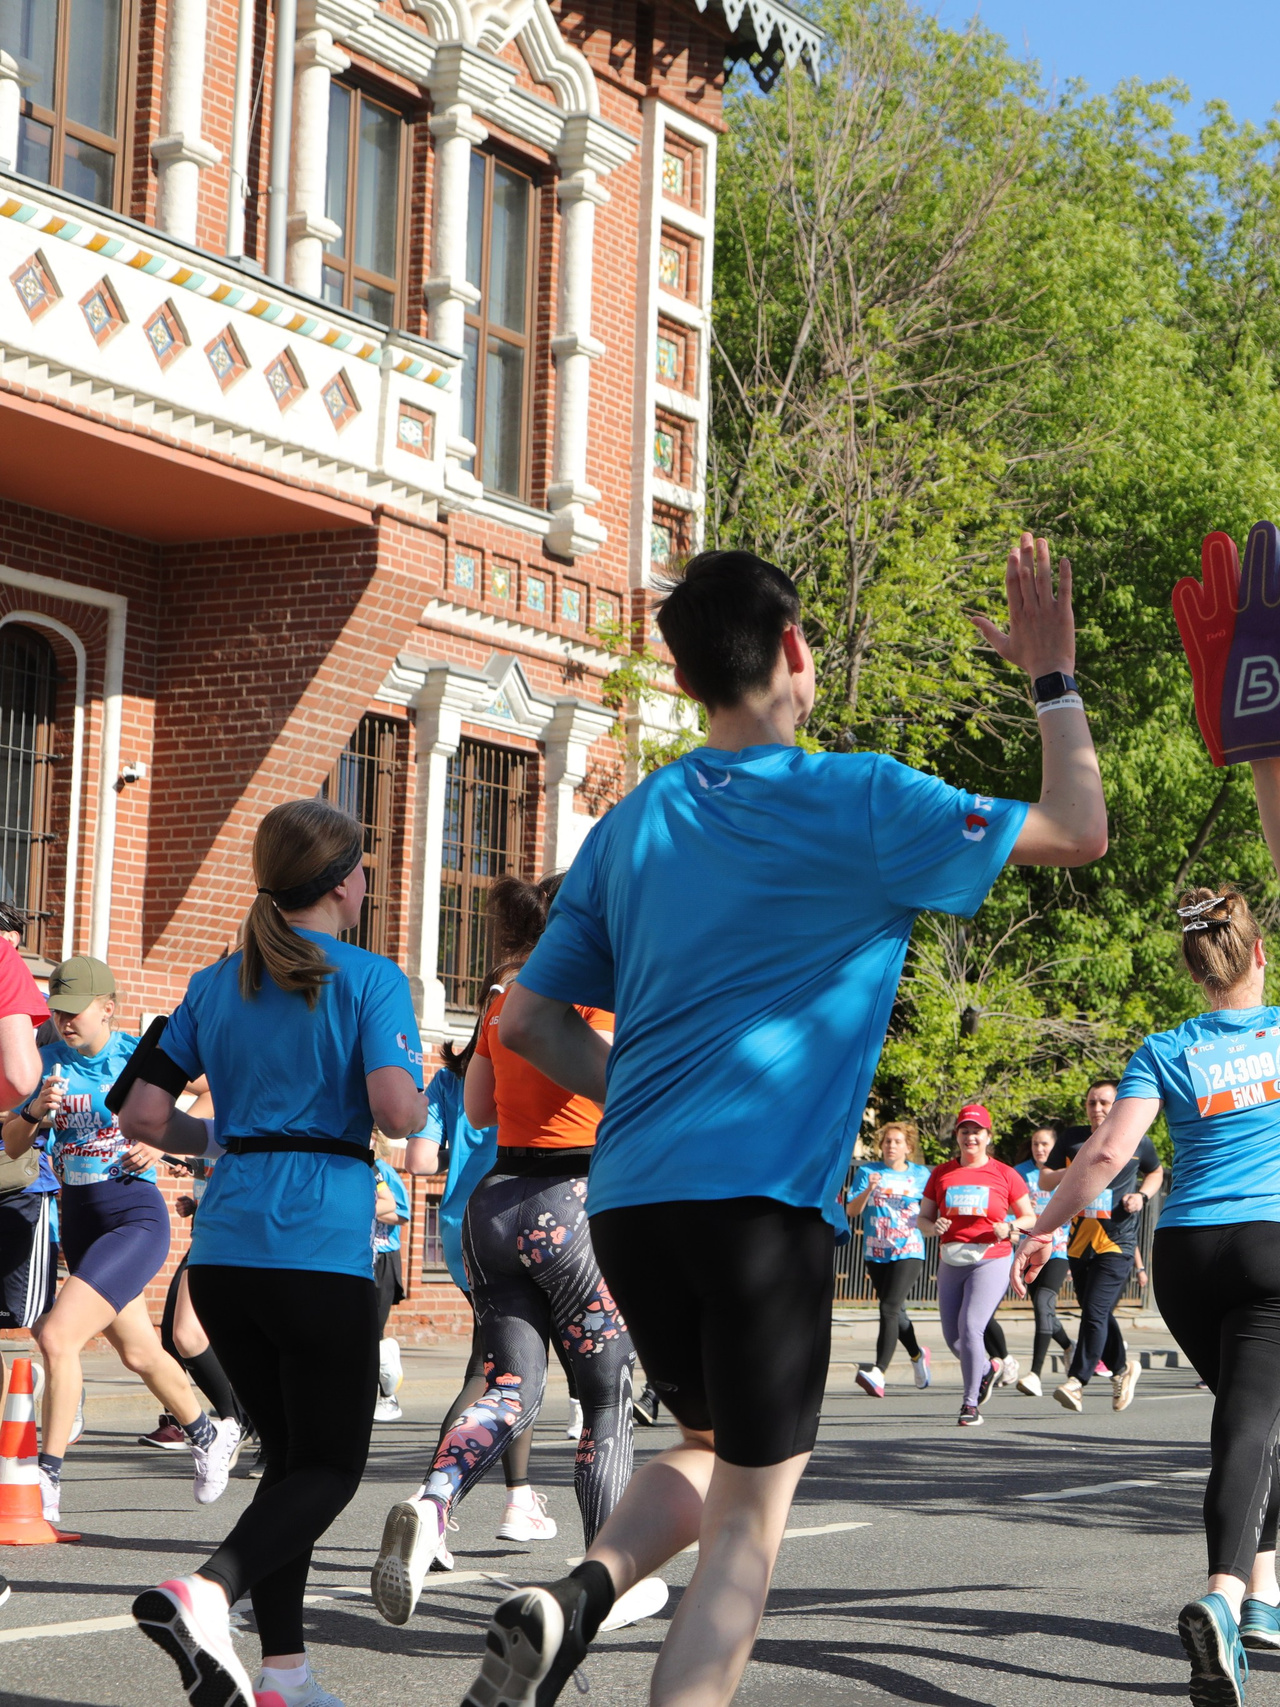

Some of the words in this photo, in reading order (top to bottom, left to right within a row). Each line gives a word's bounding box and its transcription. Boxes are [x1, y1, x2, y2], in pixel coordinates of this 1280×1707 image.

[1208, 1051, 1276, 1090] 24309
[60, 1093, 92, 1113] ЕЧТА
[1231, 1083, 1266, 1109] 5KM
